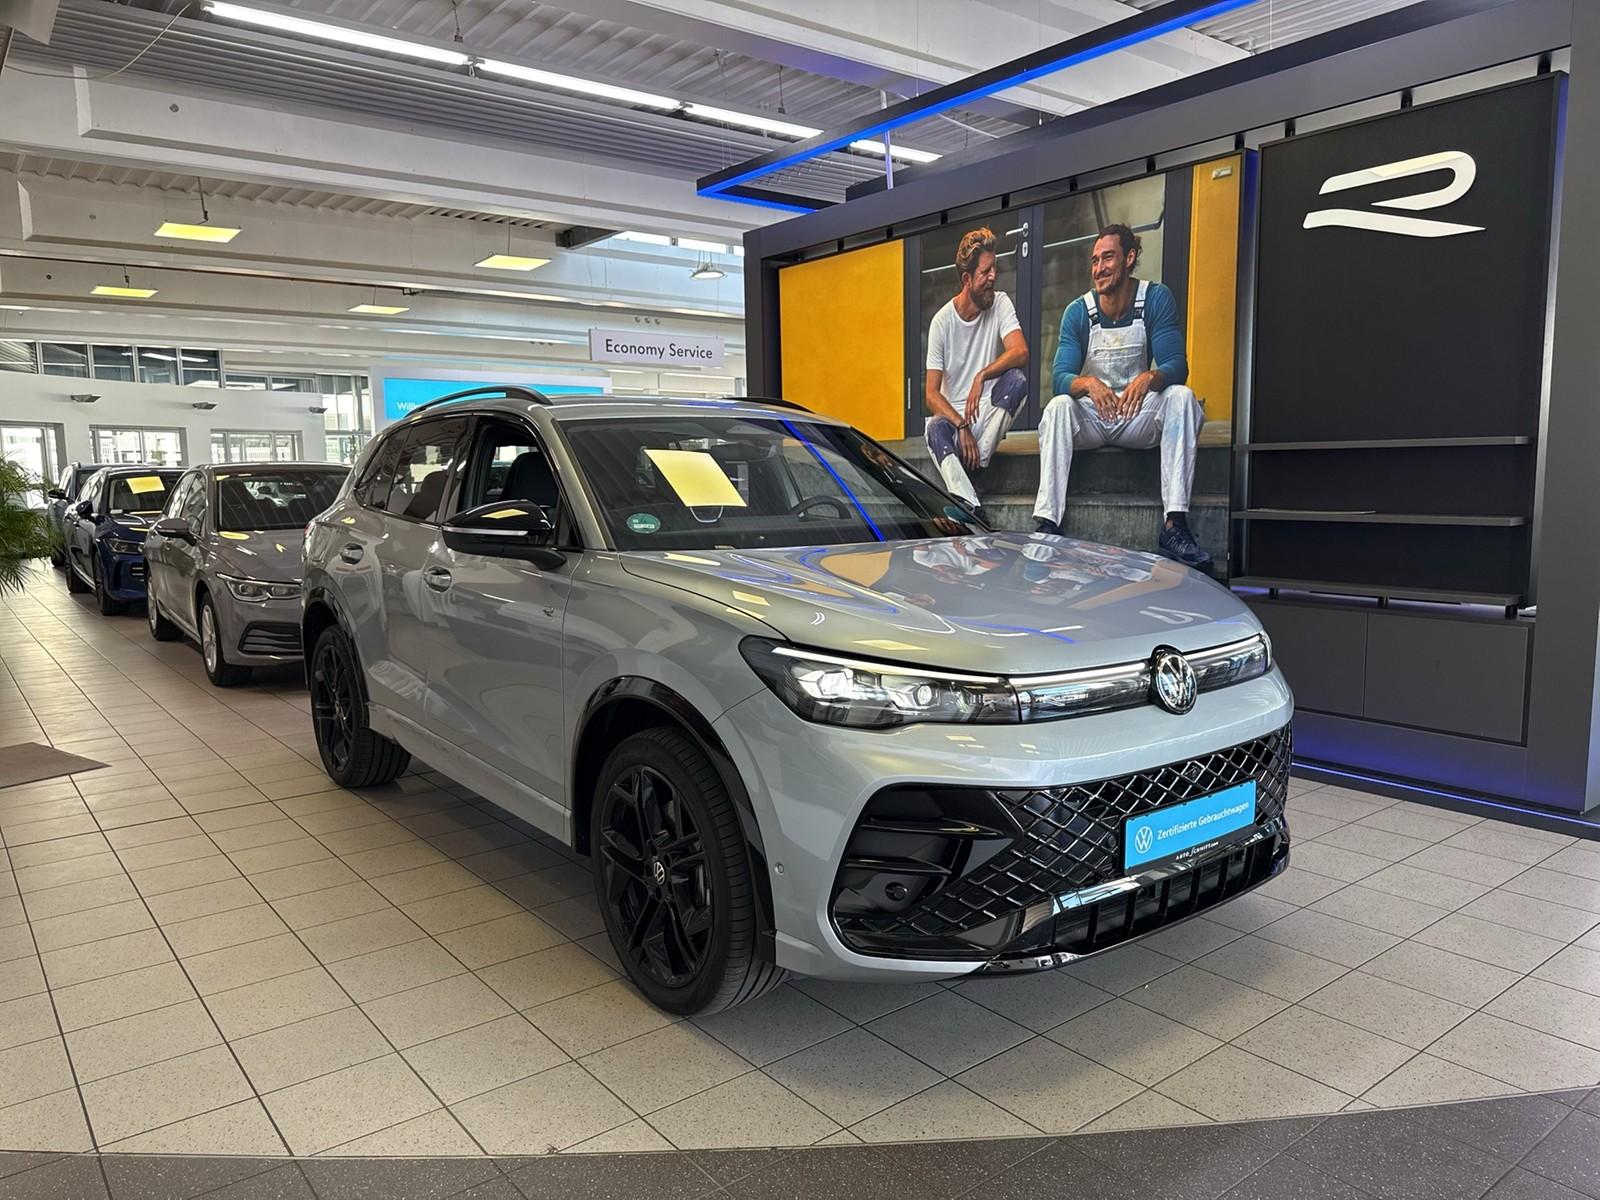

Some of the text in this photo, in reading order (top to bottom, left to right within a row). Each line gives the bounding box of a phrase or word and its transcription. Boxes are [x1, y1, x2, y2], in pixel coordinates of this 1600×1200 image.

[605, 338, 713, 359] Economy Service
[1157, 801, 1250, 840] Zertifizierte Gebrauchtwagen
